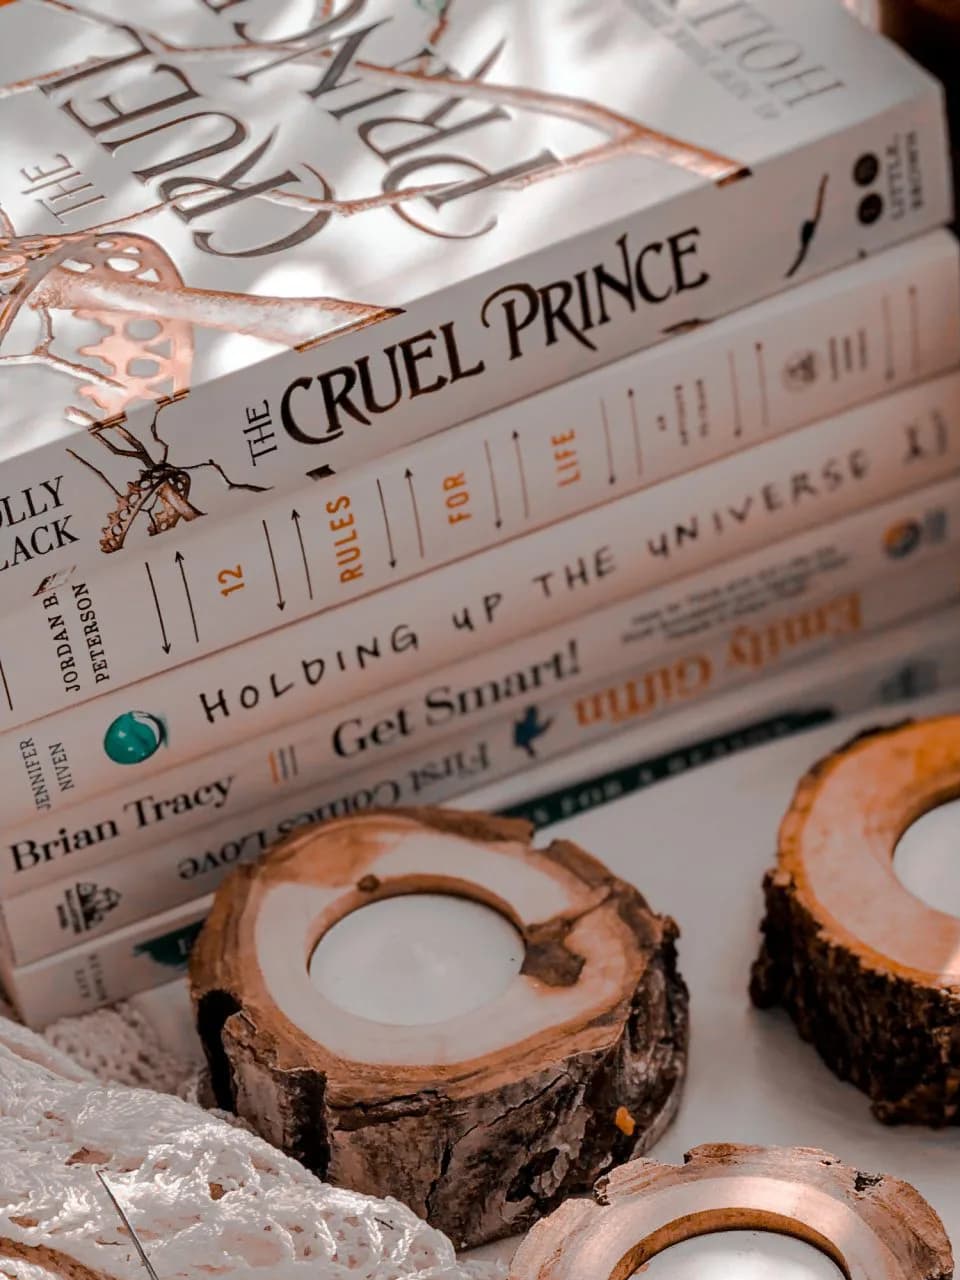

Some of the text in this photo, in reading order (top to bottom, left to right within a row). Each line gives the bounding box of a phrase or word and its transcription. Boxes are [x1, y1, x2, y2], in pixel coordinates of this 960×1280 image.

[668, 0, 846, 107] HOLL
[40, 24, 333, 258] CRUEL
[20, 152, 106, 225] THE
[243, 226, 711, 467] THE CRUEL PRINCE
[0, 475, 64, 529] LLY
[0, 514, 81, 572] ACK
[217, 427, 582, 597] 12 RULES FOR LIFE
[43, 592, 81, 692] JORDAN B.
[72, 583, 110, 684] PETERSON
[200, 624, 420, 724] HOLDING
[532, 545, 617, 598] THE
[723, 590, 863, 671] Emily
[9, 638, 583, 875] Brian Tracy Get Smart!
[20, 736, 52, 811] JENNIFER
[49, 742, 75, 791] NIVEN
[408, 742, 492, 794] First
[178, 829, 269, 882] Love
